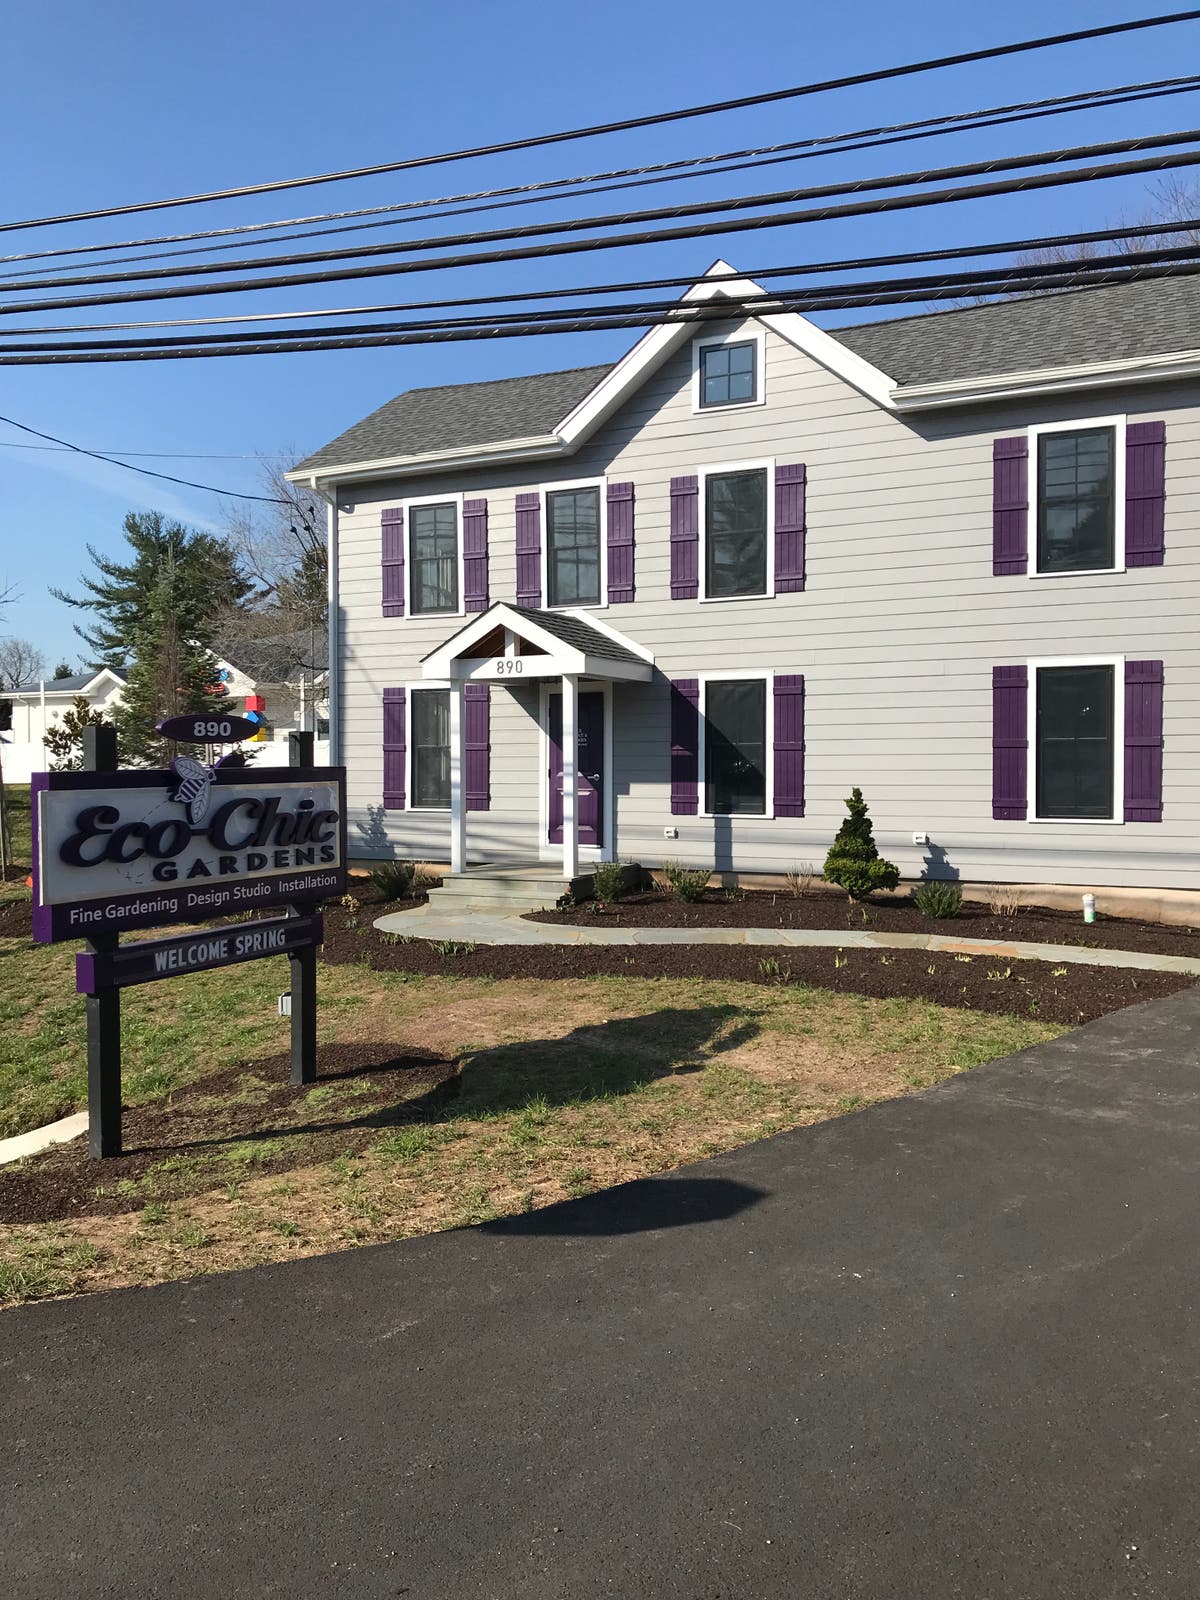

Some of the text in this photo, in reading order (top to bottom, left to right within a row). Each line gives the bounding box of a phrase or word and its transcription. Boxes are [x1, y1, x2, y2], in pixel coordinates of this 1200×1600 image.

[496, 660, 523, 674] 890
[193, 721, 232, 737] 890
[153, 845, 336, 882] GARDENS
[70, 874, 337, 925] Fine Gardening Design Studio Installation
[154, 928, 286, 972] WELCOME SPRING
